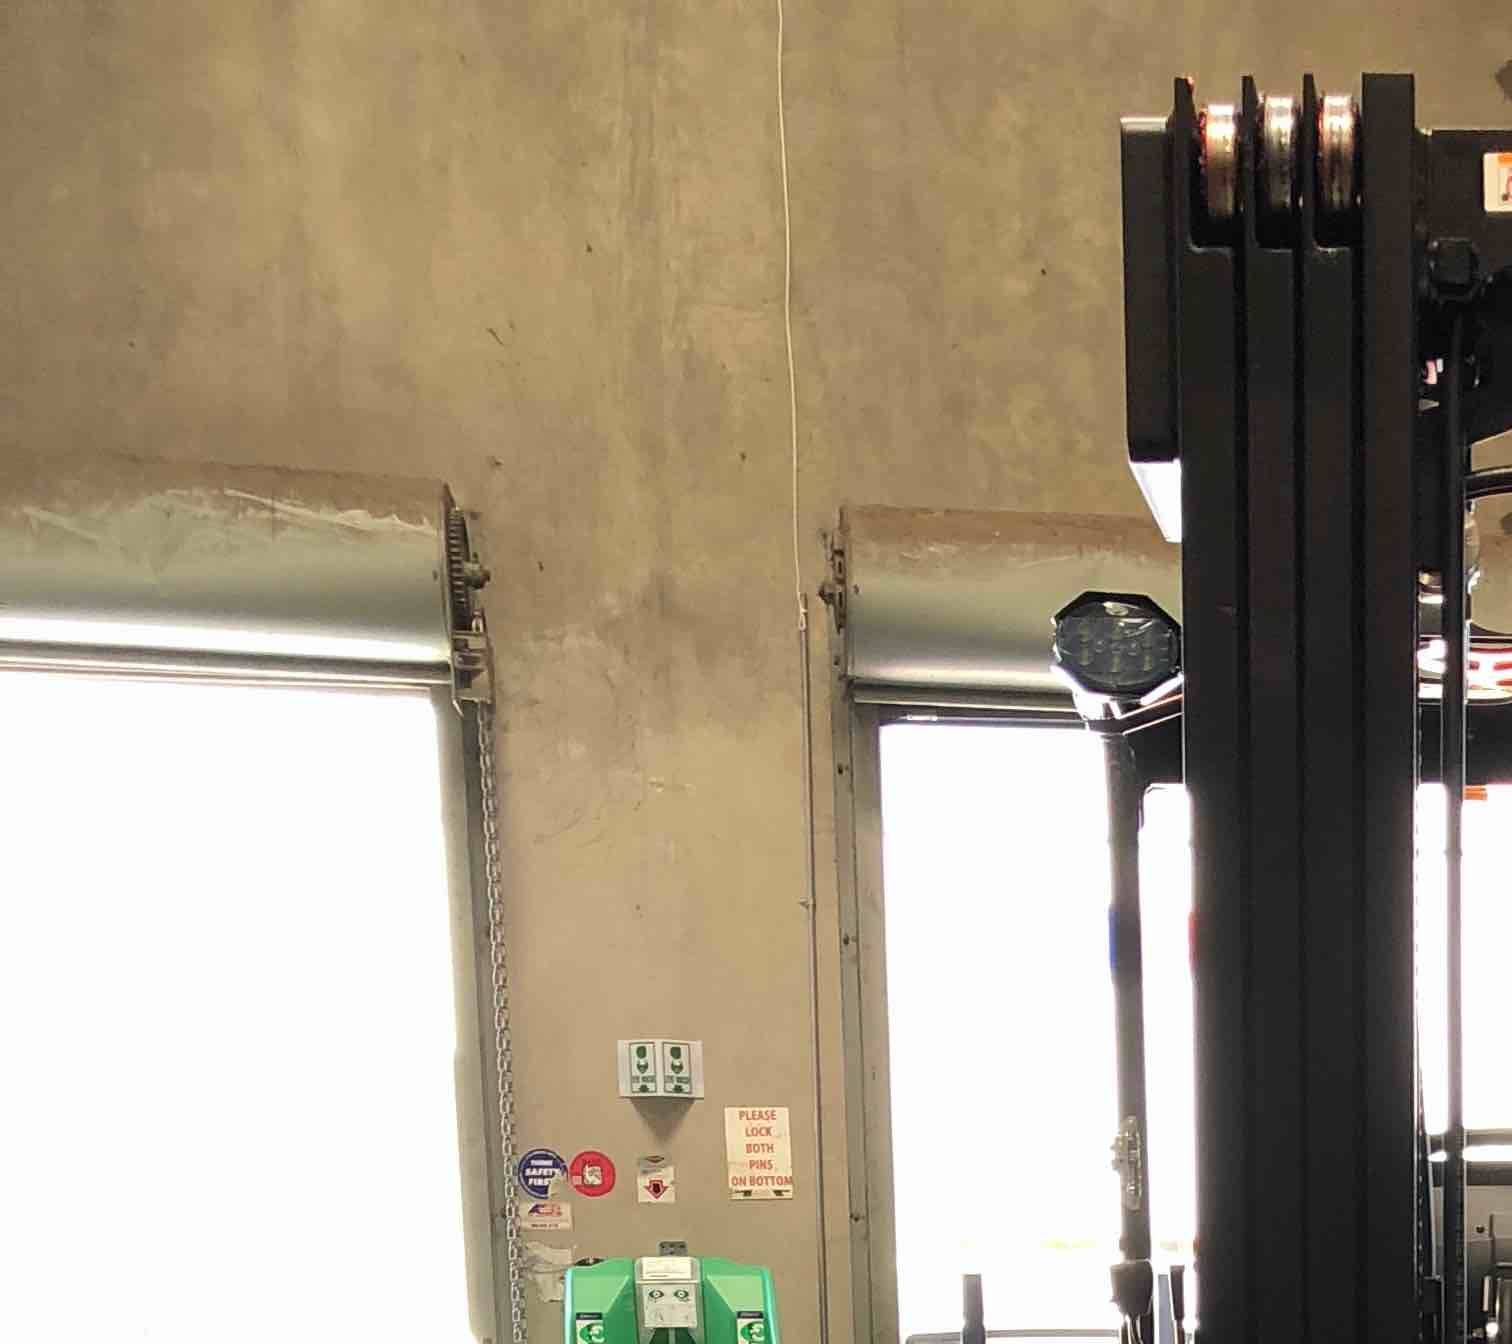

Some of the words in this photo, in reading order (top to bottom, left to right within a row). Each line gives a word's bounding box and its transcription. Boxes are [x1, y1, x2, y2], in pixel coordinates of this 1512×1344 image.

[738, 1110, 777, 1121] PLEASE
[745, 1127, 772, 1137] LOCK
[745, 1143, 775, 1153] BOTH
[748, 1159, 774, 1170] PINS
[525, 1167, 562, 1177] SAFETY
[731, 1176, 747, 1186] ON
[749, 1176, 794, 1186] BOTTOM
